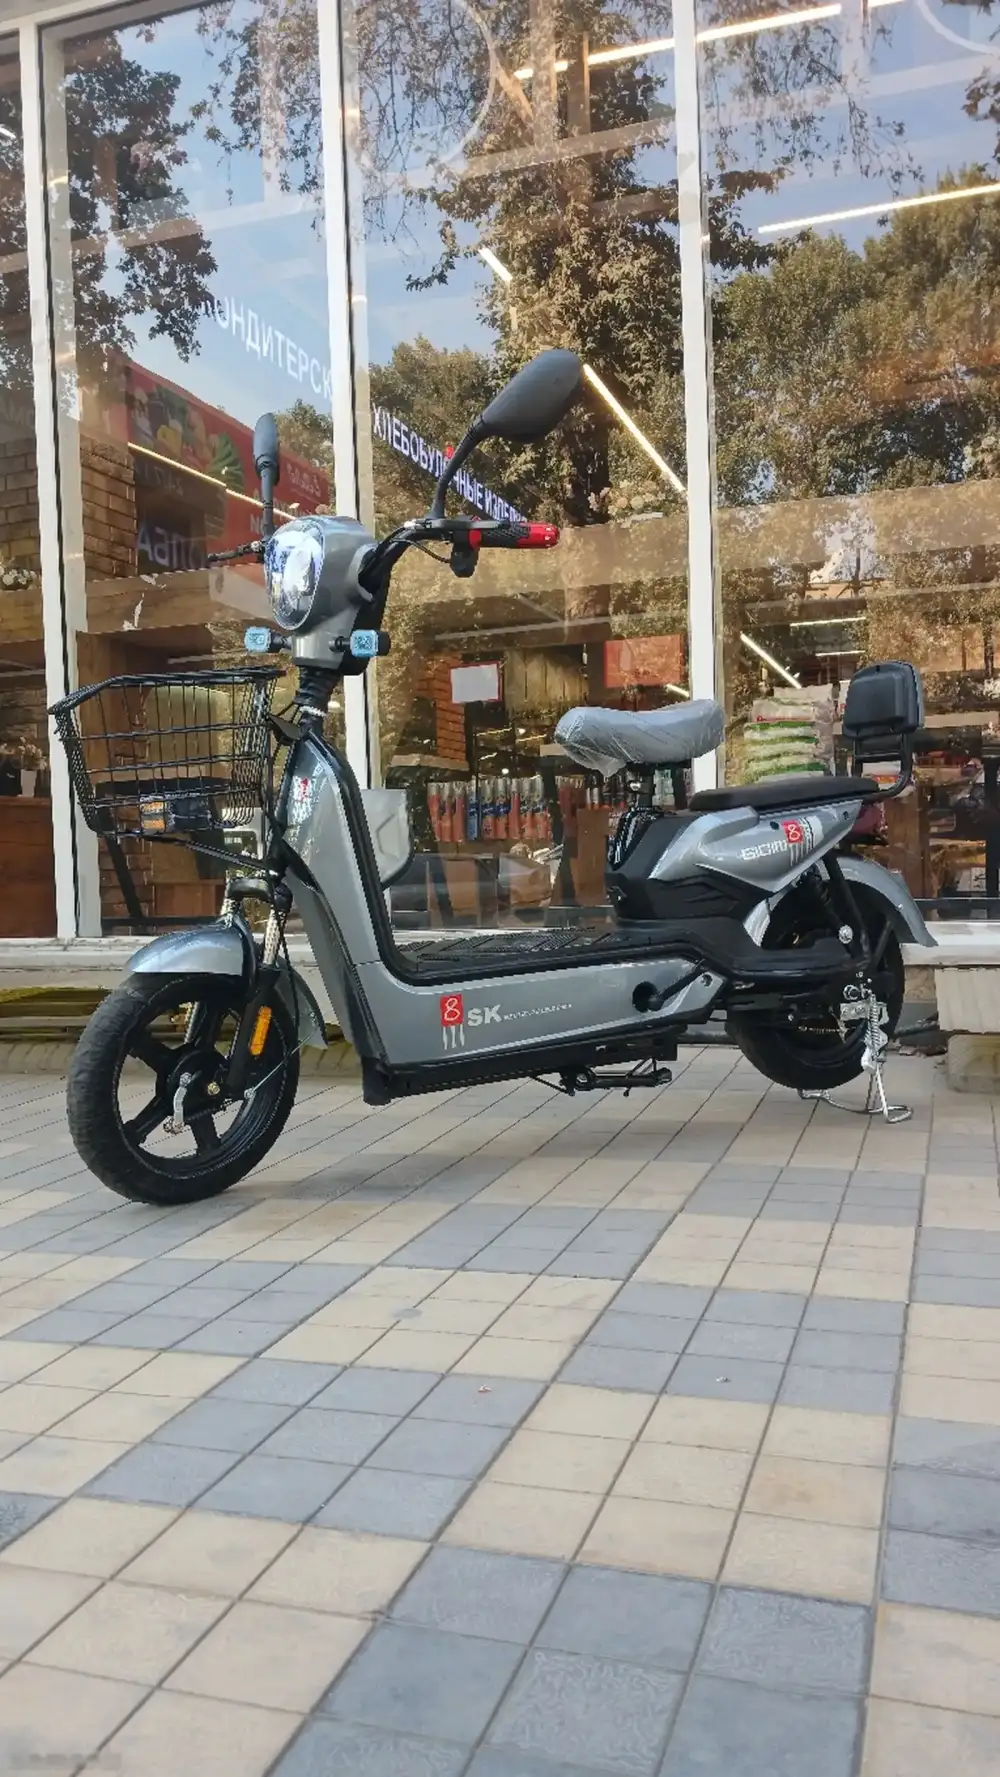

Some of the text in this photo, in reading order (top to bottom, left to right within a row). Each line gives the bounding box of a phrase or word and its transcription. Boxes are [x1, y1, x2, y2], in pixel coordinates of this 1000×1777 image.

[372, 402, 484, 511] ХЛЕБОБУЛЧНЫЕ
[444, 997, 460, 1021] 8
[467, 1004, 502, 1027] SK
